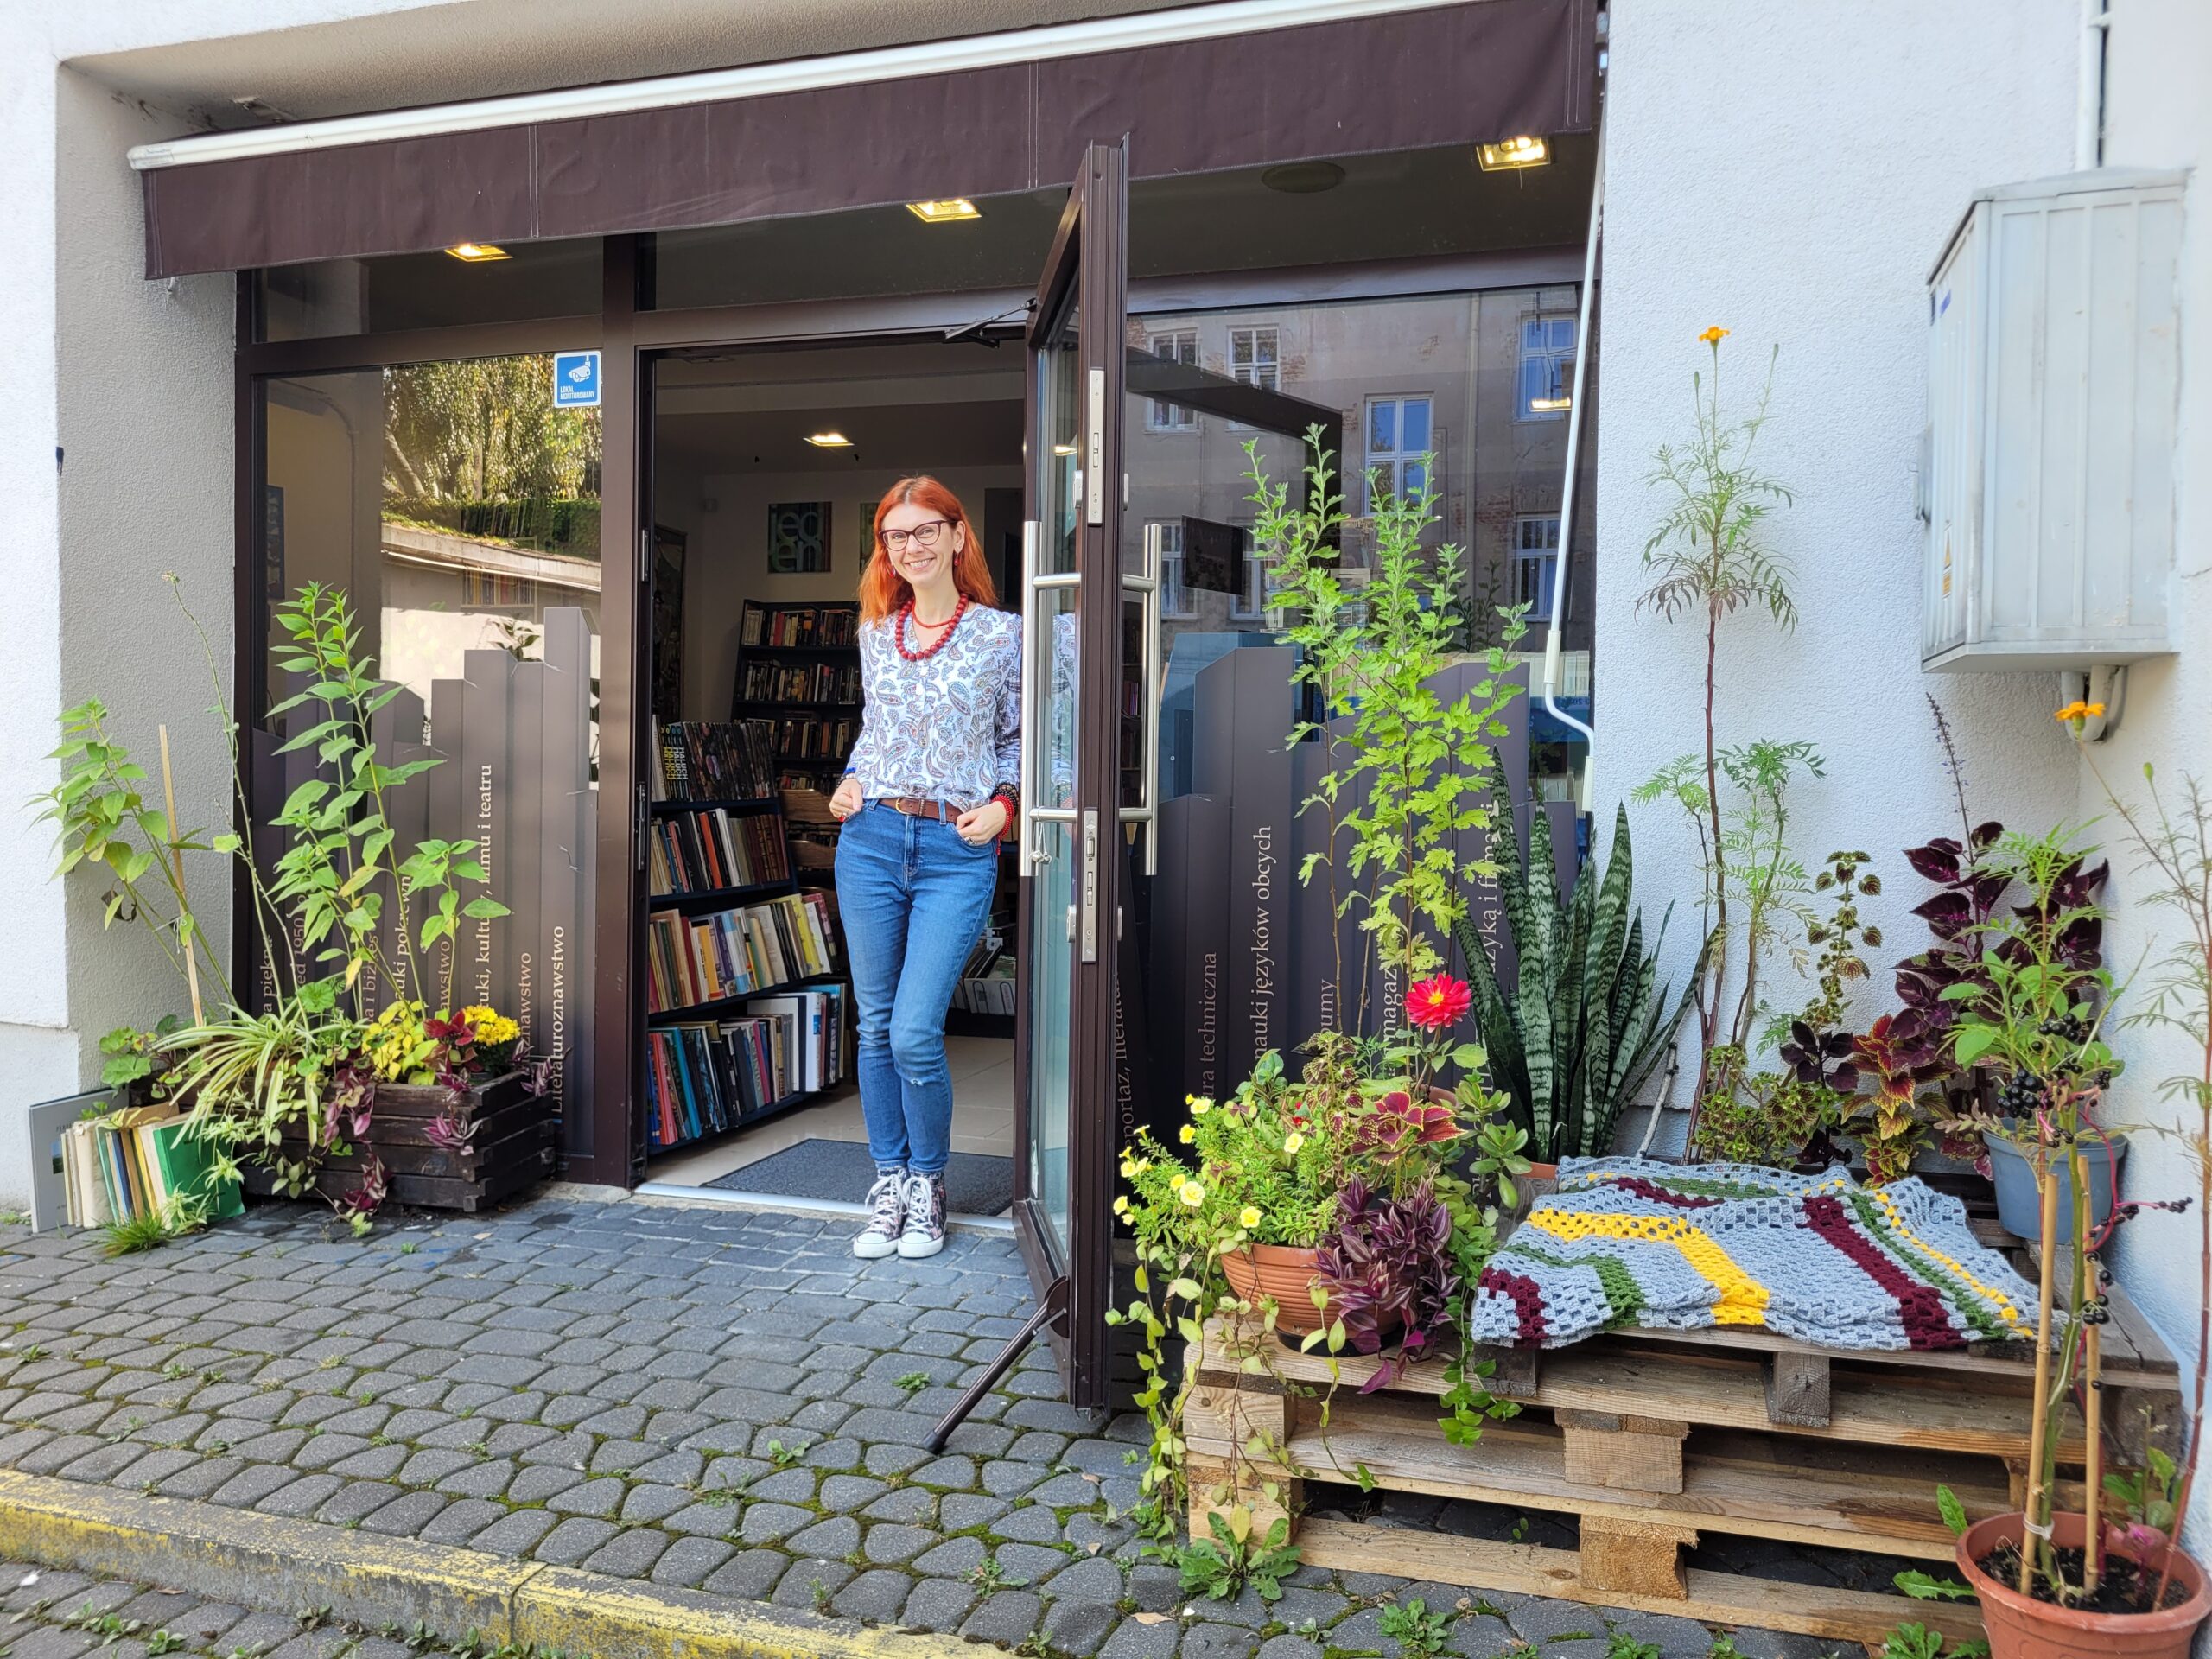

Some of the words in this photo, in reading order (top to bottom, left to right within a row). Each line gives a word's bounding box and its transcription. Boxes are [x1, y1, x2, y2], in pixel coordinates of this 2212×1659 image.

[560, 391, 595, 400] MONITOROWANY
[477, 765, 493, 819] teatru
[1251, 825, 1277, 901] obcych
[1478, 894, 1497, 903] i
[1250, 906, 1275, 997] języków
[391, 962, 407, 1000] auki
[474, 969, 493, 1009] tuki,
[1198, 951, 1217, 1063] techniczna
[550, 925, 565, 1114] Literaturoznawstwo
